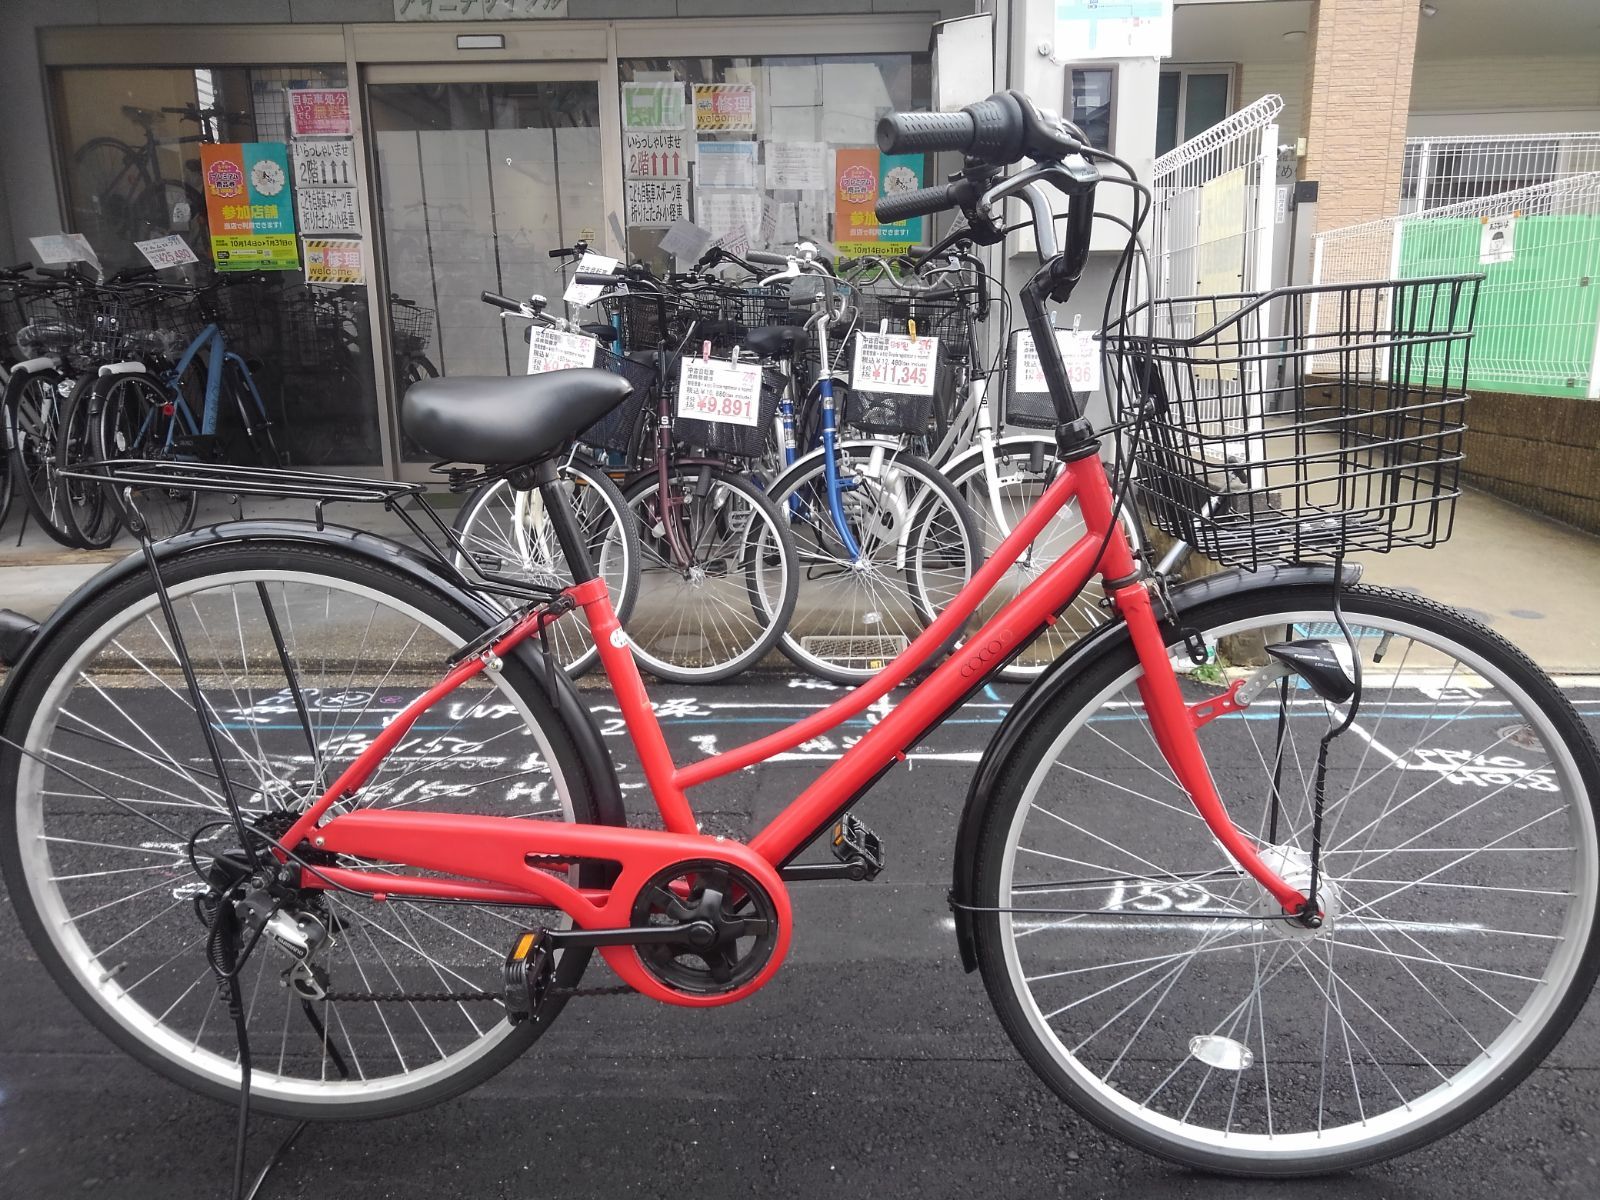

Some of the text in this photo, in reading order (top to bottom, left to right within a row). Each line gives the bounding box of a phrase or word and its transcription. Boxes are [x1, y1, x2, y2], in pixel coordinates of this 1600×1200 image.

[292, 94, 347, 105] 自転車処分
[716, 95, 751, 113] 修理
[295, 142, 349, 157] いらっしゃいませ
[627, 135, 682, 149] いらっしゃいませ
[299, 159, 319, 184] 2階
[630, 151, 649, 176] 2階
[300, 189, 353, 211] こども自転車スポーツ車
[629, 182, 682, 203] こども自転車スポーツ車
[222, 205, 279, 219] 参加店舗
[326, 251, 361, 268] 修理
[872, 364, 927, 385] ¥11,345
[697, 395, 752, 417] ¥9,891
